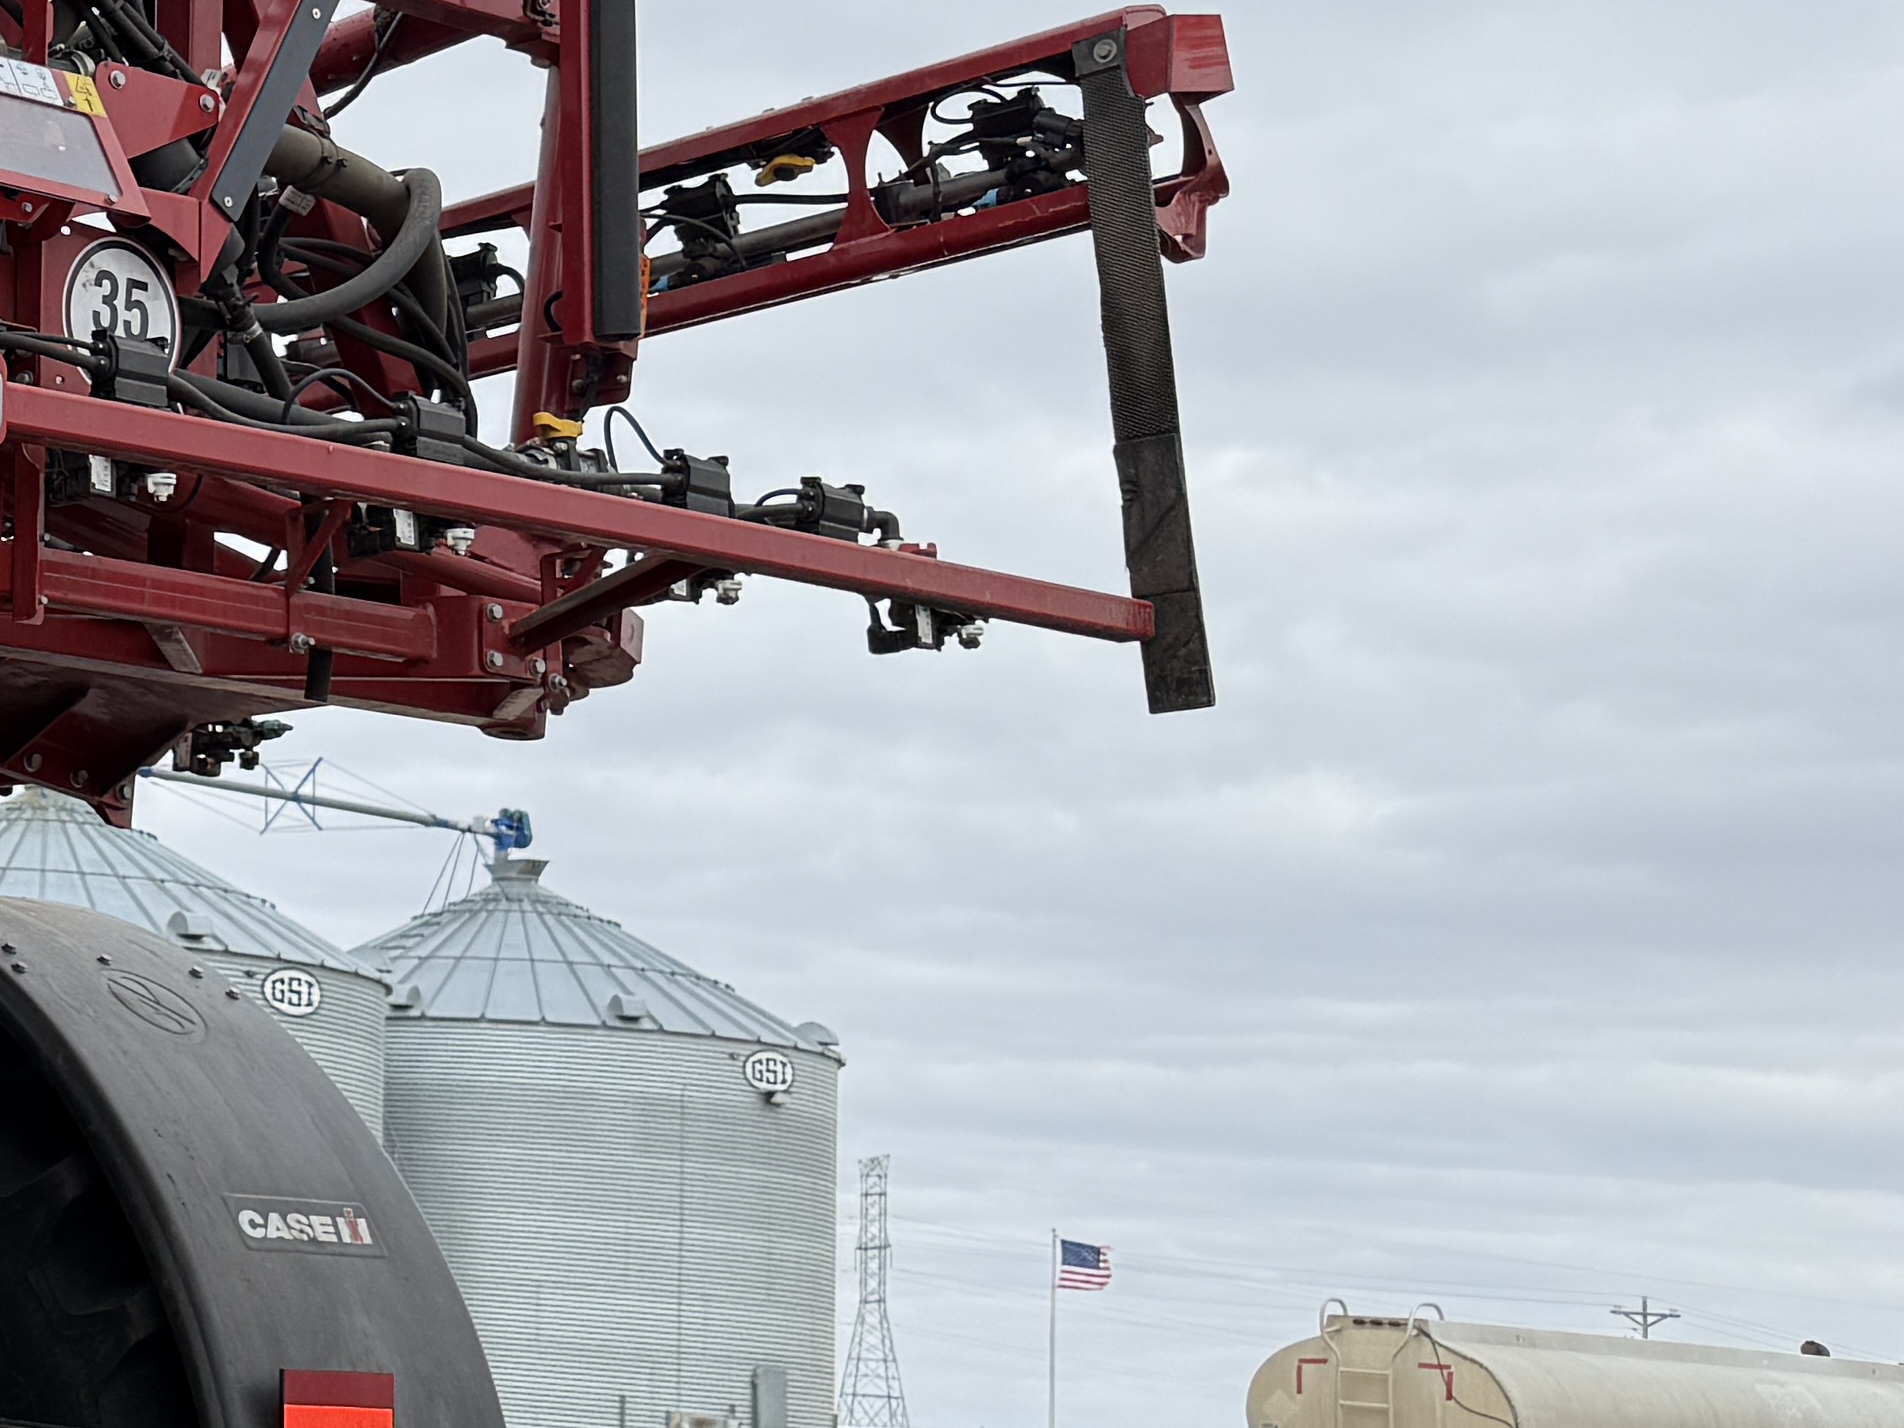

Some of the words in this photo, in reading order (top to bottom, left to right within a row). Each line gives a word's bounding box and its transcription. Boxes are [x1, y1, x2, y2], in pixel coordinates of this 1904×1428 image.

[92, 269, 149, 341] 35
[271, 974, 314, 1008] GSI
[750, 1057, 788, 1086] GSI
[237, 1208, 334, 1244] CASE
